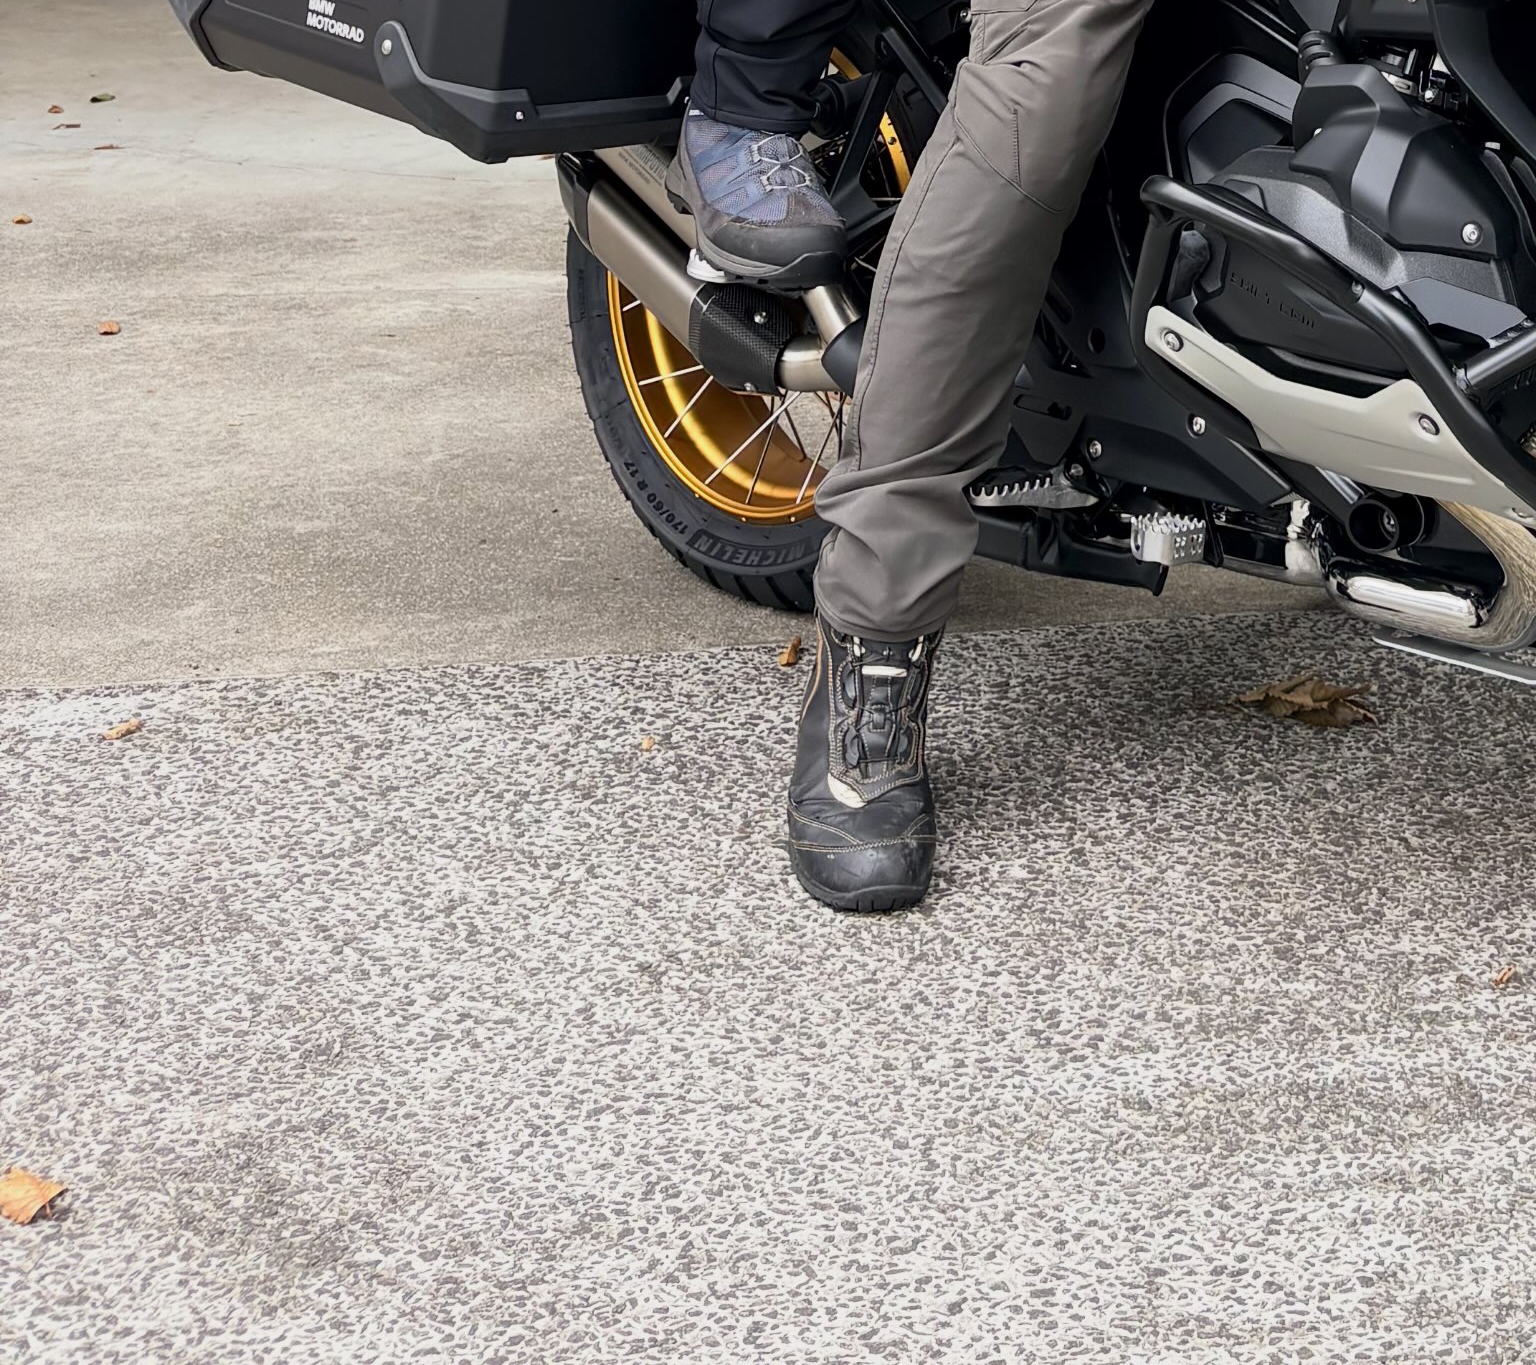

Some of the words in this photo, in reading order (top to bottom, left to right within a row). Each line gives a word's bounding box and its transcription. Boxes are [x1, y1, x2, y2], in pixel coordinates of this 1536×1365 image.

[306, 11, 365, 43] MOTORRAD
[623, 460, 640, 478] 17
[636, 479, 648, 491] R
[646, 493, 689, 535] 170/60
[694, 534, 807, 566] MICHELIN
